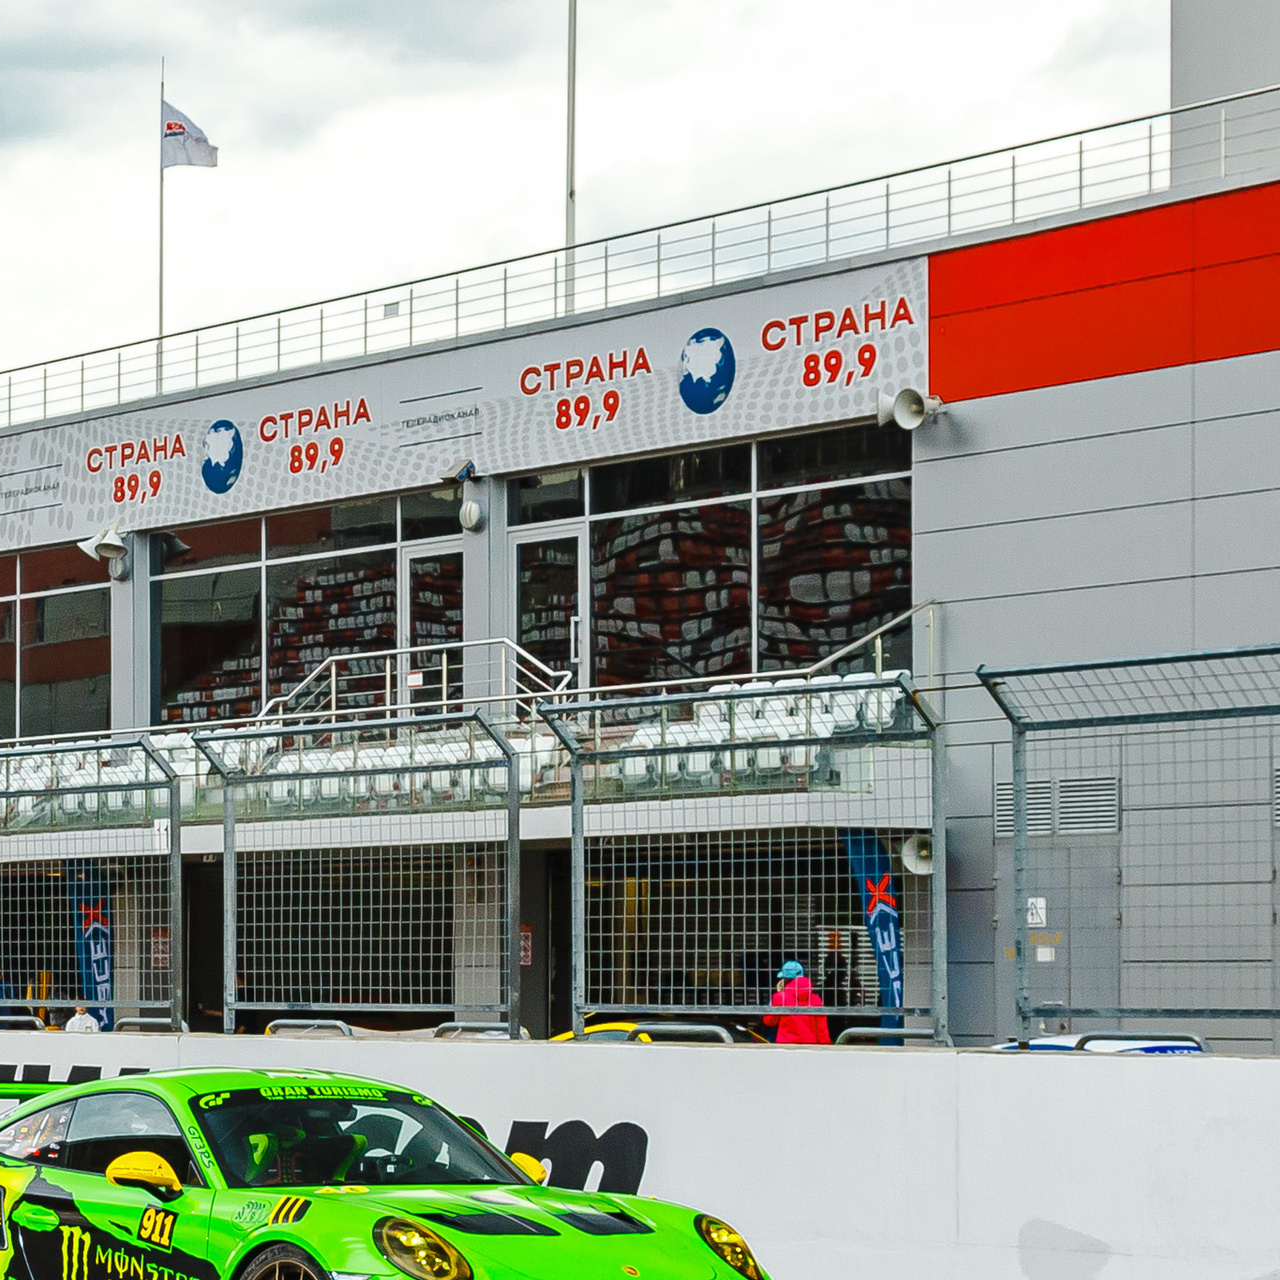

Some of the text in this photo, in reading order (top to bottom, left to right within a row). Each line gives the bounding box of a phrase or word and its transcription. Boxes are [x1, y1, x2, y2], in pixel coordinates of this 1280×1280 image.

[761, 297, 915, 351] СТРАНА
[520, 347, 651, 395] СТРАНА
[802, 343, 877, 387] 89,9
[259, 398, 371, 443] СТРАНА
[556, 390, 620, 430] 89,9
[86, 434, 186, 473] СТРАНА
[288, 437, 345, 475] 89,9
[113, 470, 162, 505] 89,9
[260, 1086, 383, 1098] GRAN TURISMO
[187, 1125, 216, 1169] GT3RS
[140, 1208, 174, 1248] 911
